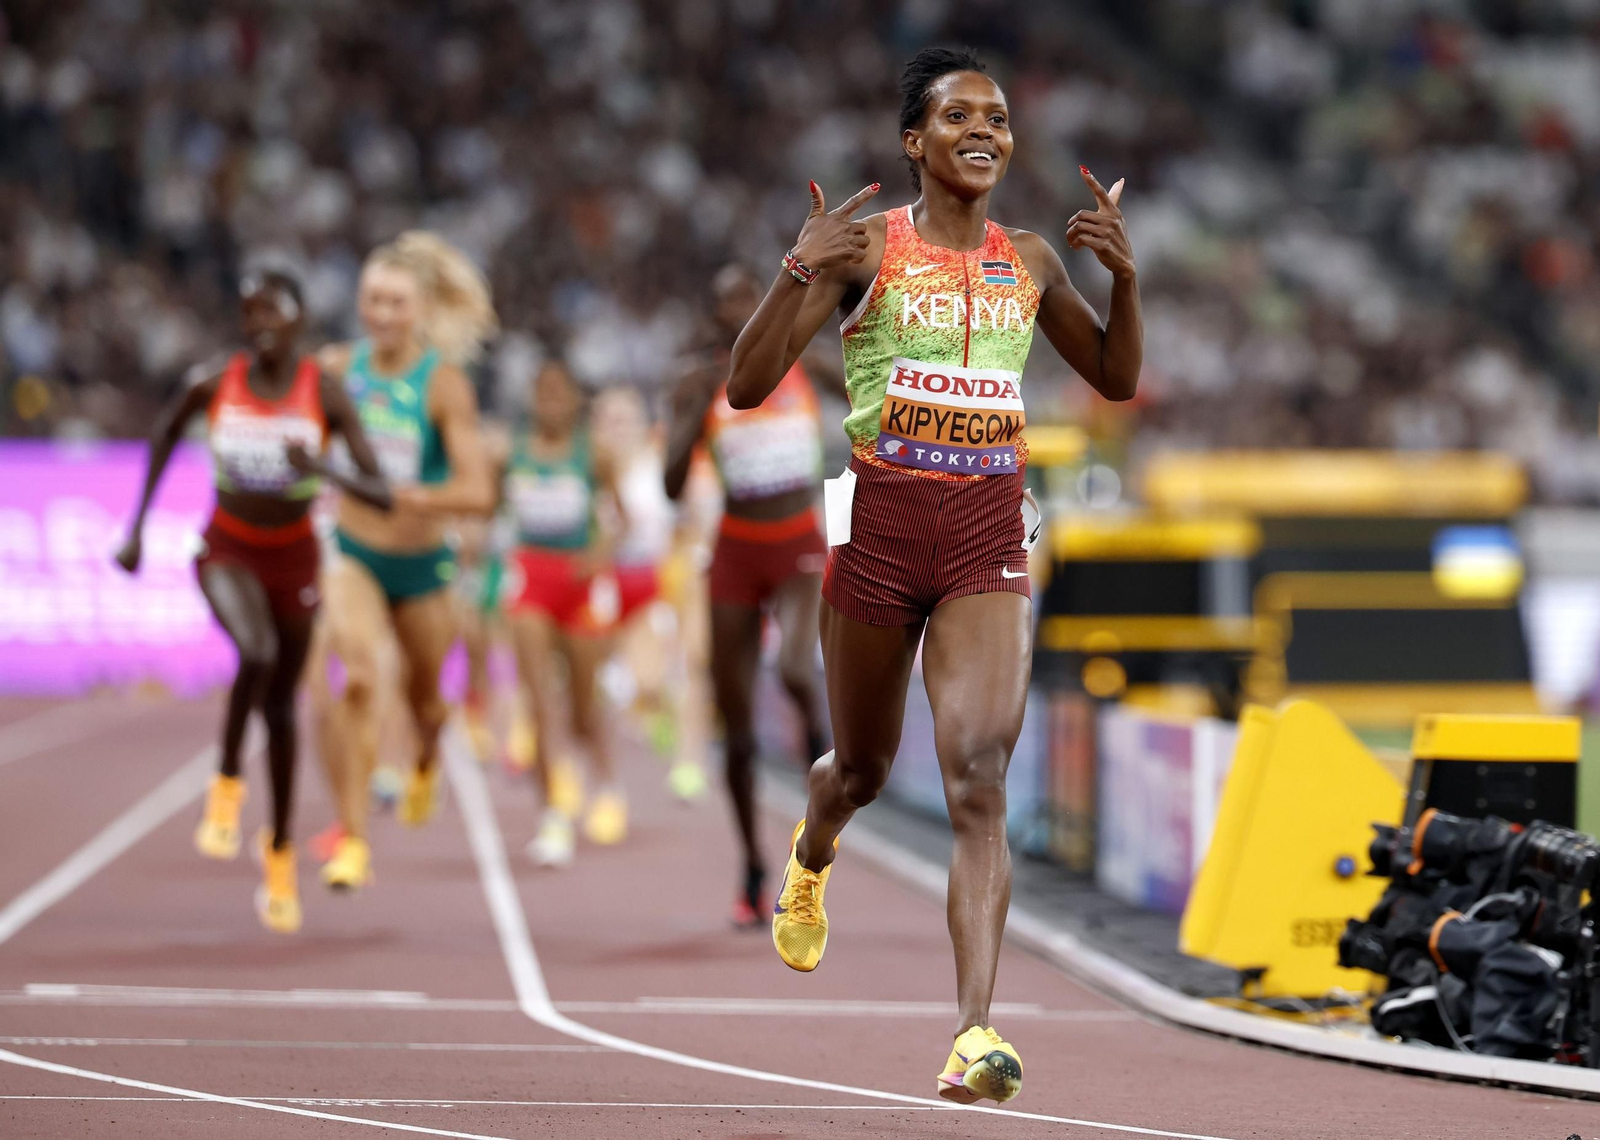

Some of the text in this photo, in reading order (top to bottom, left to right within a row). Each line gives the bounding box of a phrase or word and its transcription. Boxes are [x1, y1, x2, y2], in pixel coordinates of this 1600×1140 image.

[902, 292, 1025, 331] KENYA
[892, 367, 1020, 399] HONDA
[888, 401, 1020, 445] KIPYEGON
